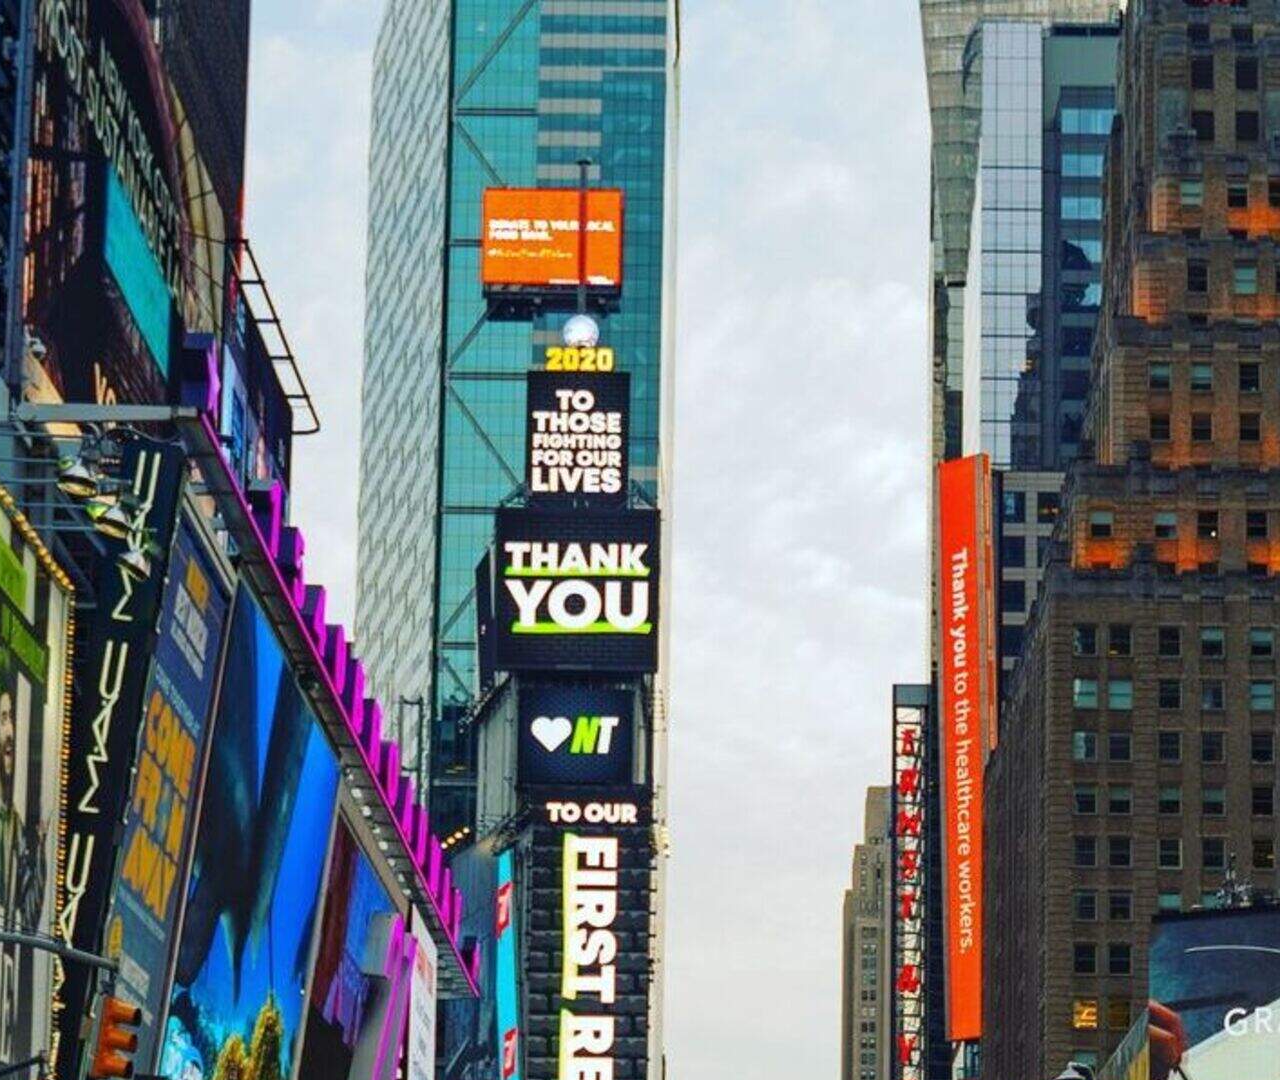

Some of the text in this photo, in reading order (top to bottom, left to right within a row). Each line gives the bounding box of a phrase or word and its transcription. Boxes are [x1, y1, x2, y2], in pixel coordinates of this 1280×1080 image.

[545, 347, 614, 372] 2020
[556, 390, 595, 411] TO
[532, 412, 622, 433] THOSE
[532, 434, 622, 450] FIGHTING
[531, 450, 622, 467] FOR OUR
[531, 468, 622, 493] LIVES
[504, 542, 649, 572] THANK
[504, 580, 649, 630] YOU
[951, 548, 976, 955] Thank you to the healthcare workers.
[546, 802, 637, 823] TO OUR
[569, 835, 619, 1003] FIRST
